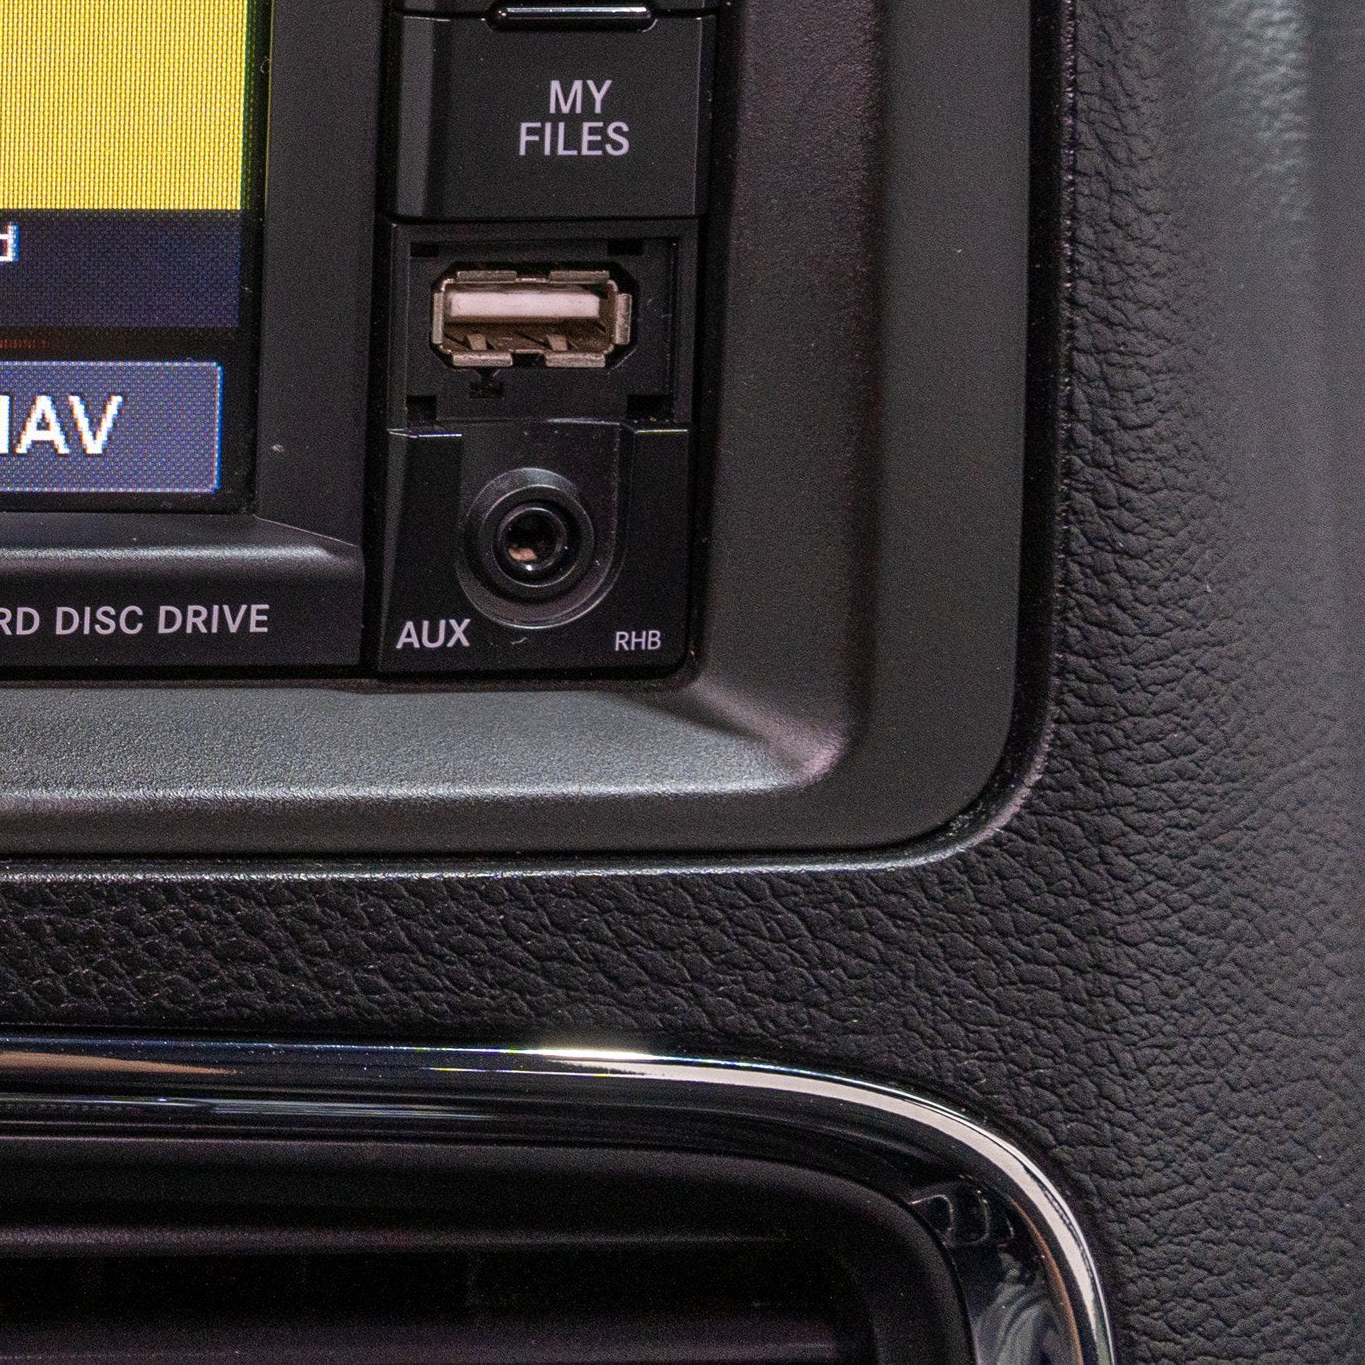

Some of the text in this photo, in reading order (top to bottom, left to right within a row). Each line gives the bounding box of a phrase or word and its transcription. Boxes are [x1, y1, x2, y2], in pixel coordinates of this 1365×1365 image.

[548, 78, 612, 115] MY
[518, 121, 630, 157] FILES
[55, 605, 144, 636] DISC
[157, 604, 270, 635] DRIVE
[396, 618, 471, 650] AUX
[614, 630, 662, 652] RHB
